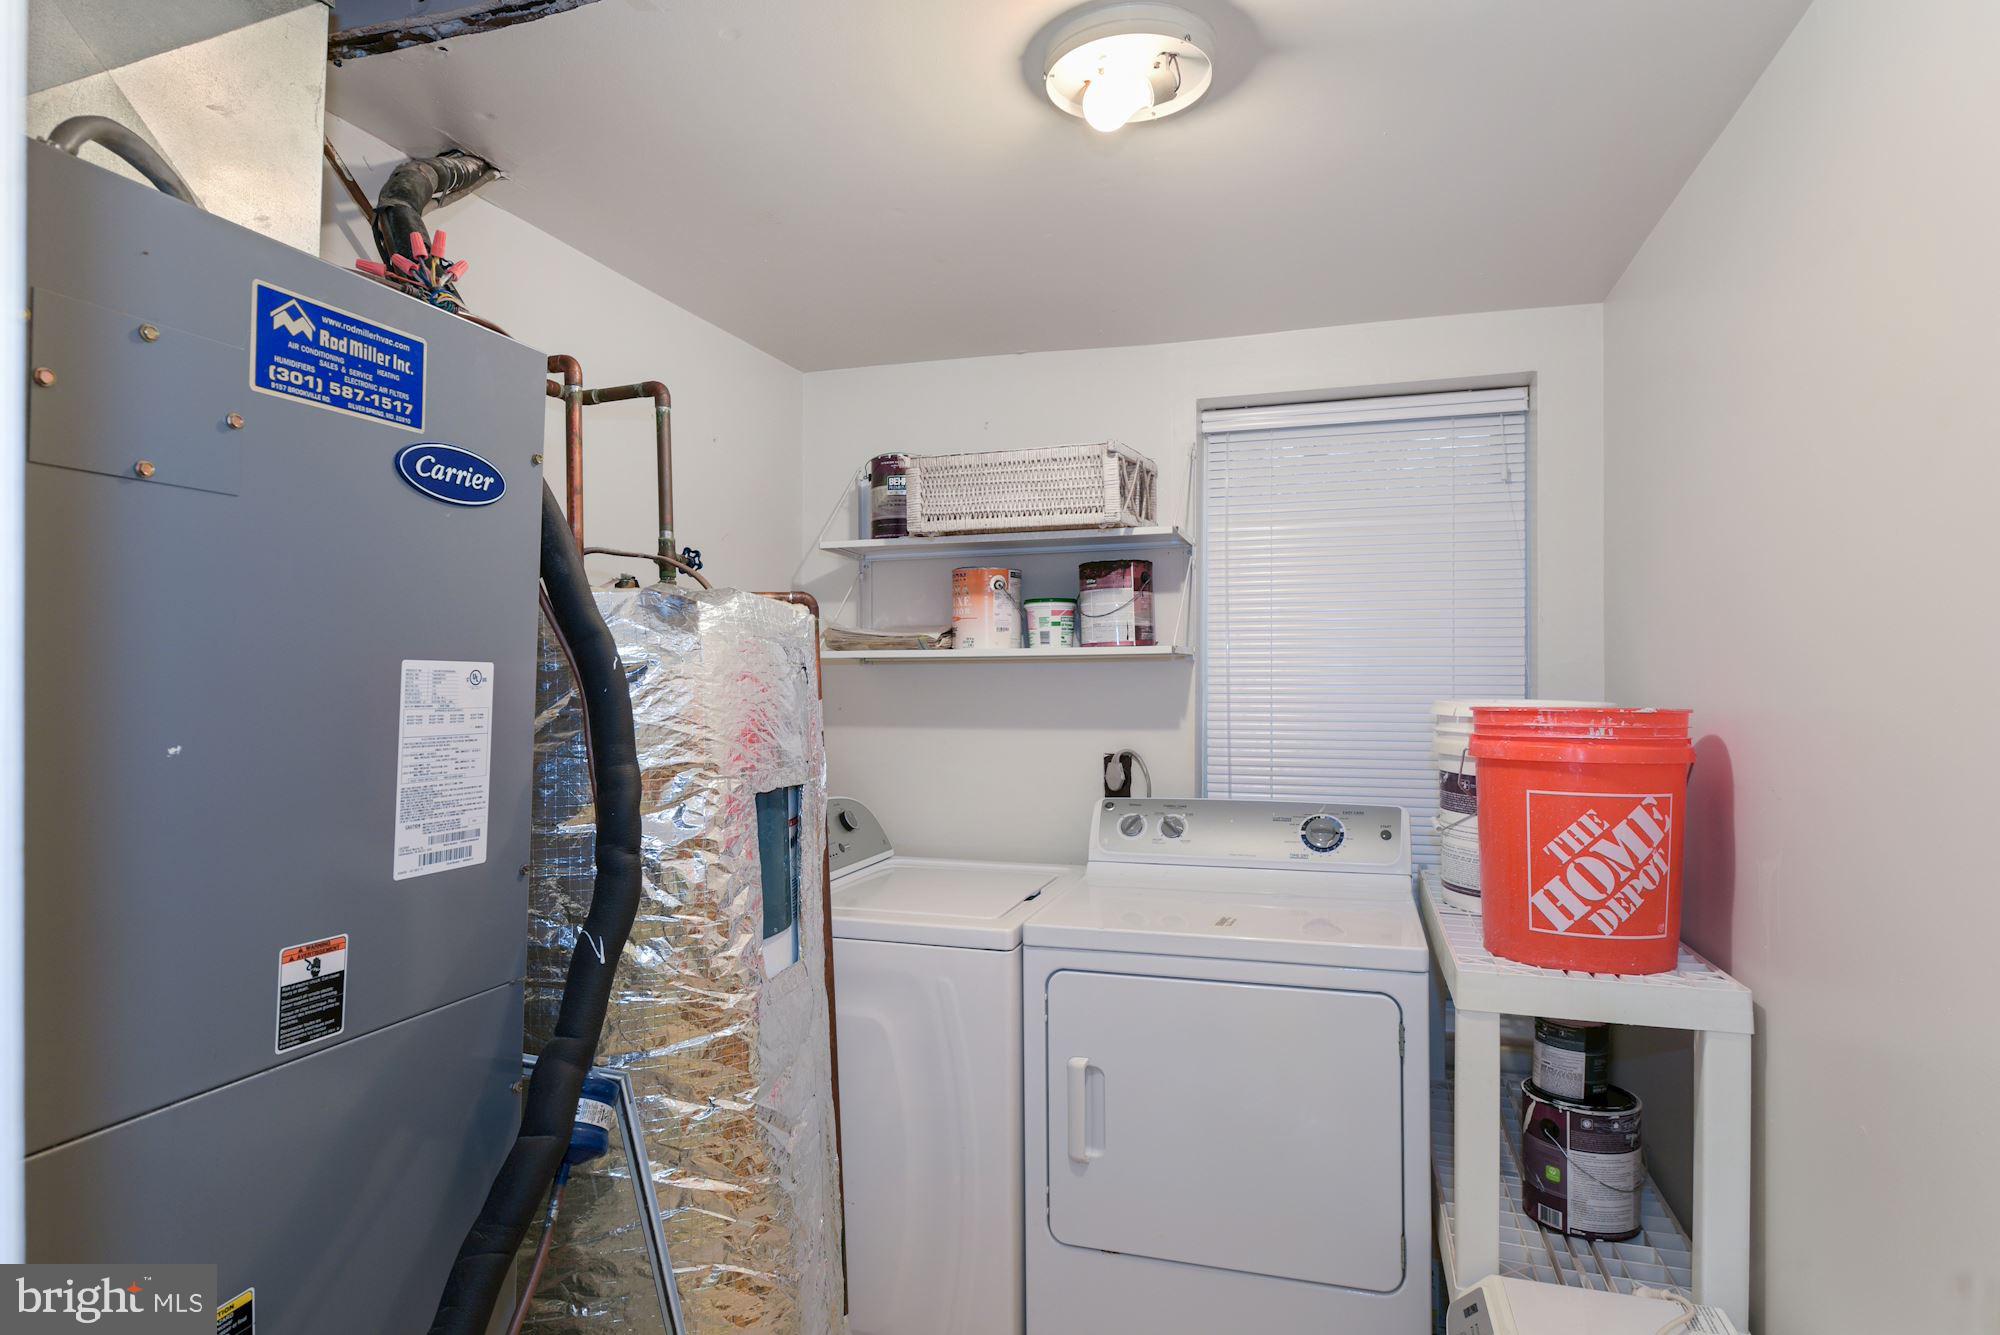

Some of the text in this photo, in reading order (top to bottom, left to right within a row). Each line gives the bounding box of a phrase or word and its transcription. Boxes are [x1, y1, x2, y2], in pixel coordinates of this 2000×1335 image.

[320, 329, 413, 375] Rod Miller Inc.
[321, 316, 410, 351] www.rodmillerhvac.com
[274, 355, 409, 400] HUMIDIFIERS ELECTRONIC AIR FILTERS
[288, 341, 400, 381] AIR CONDITIONING HEATING
[319, 360, 338, 371] SALES
[349, 368, 373, 381] SERVICE
[269, 365, 413, 415] (301) 587-1517
[415, 455, 494, 492] Carrier
[1542, 808, 1611, 864] THE
[1531, 794, 1671, 933] HOME
[1588, 848, 1669, 936] DEPOT
